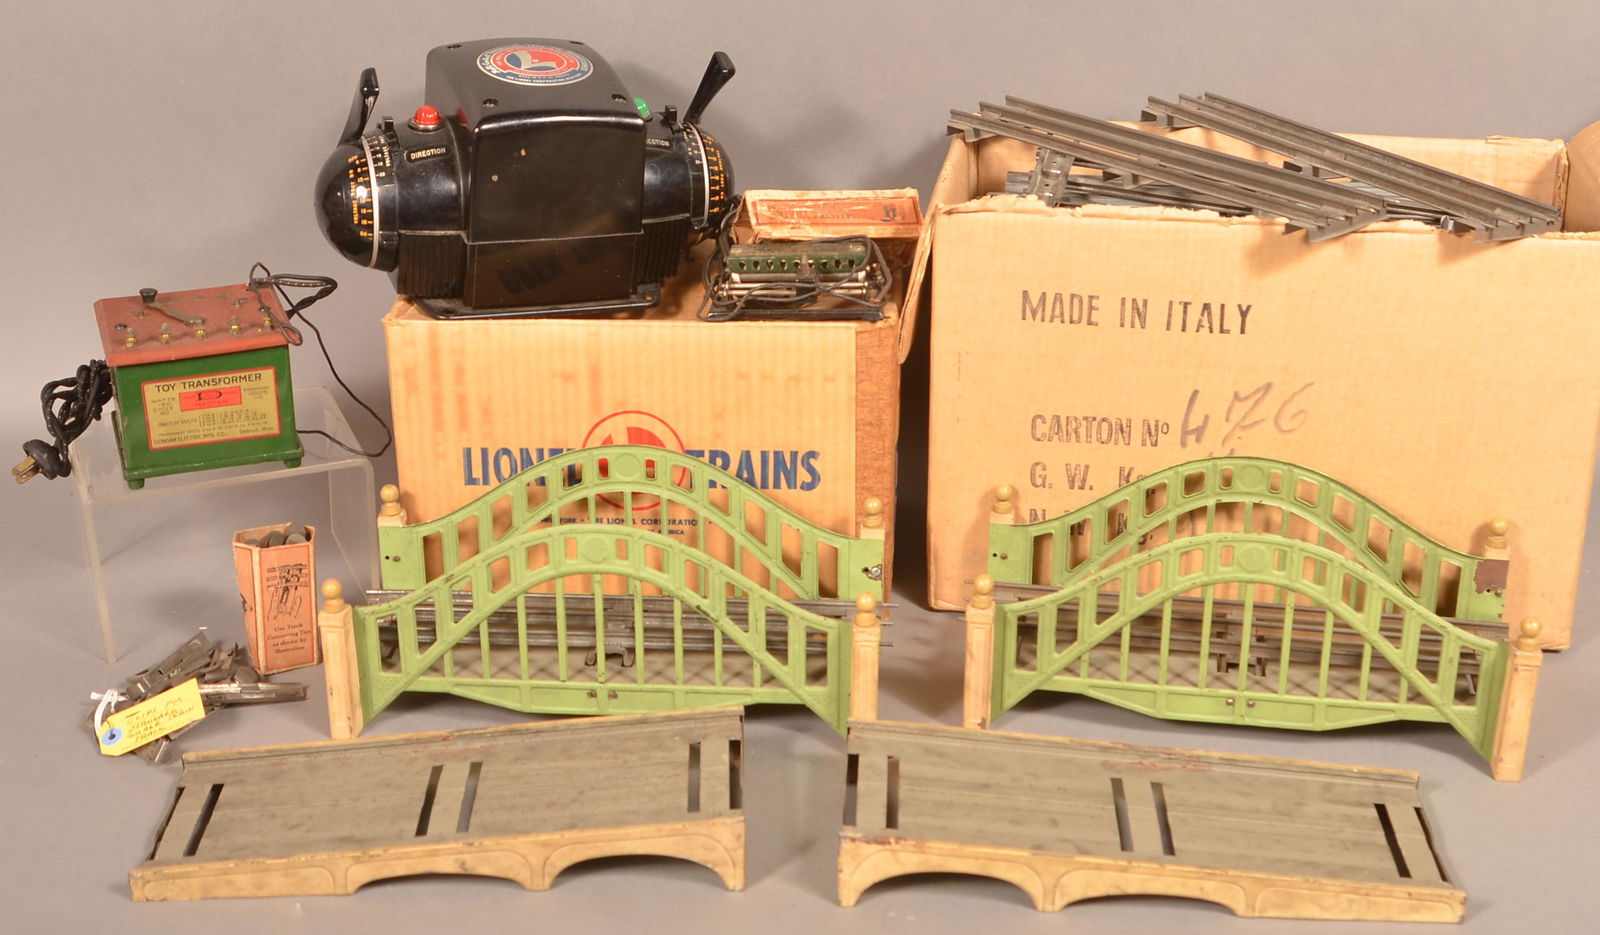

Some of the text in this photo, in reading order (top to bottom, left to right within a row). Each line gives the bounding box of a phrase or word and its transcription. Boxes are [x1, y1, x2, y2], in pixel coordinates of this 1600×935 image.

[410, 147, 446, 160] DIRECTION
[1021, 290, 1252, 335] MADE IN ITALY
[155, 382, 177, 393] TOY
[181, 372, 262, 390] TRANSFORMER
[1031, 414, 1132, 447] CARTON
[463, 447, 583, 487] LIONL
[1030, 461, 1053, 489] G.
[1065, 463, 1094, 491] W.
